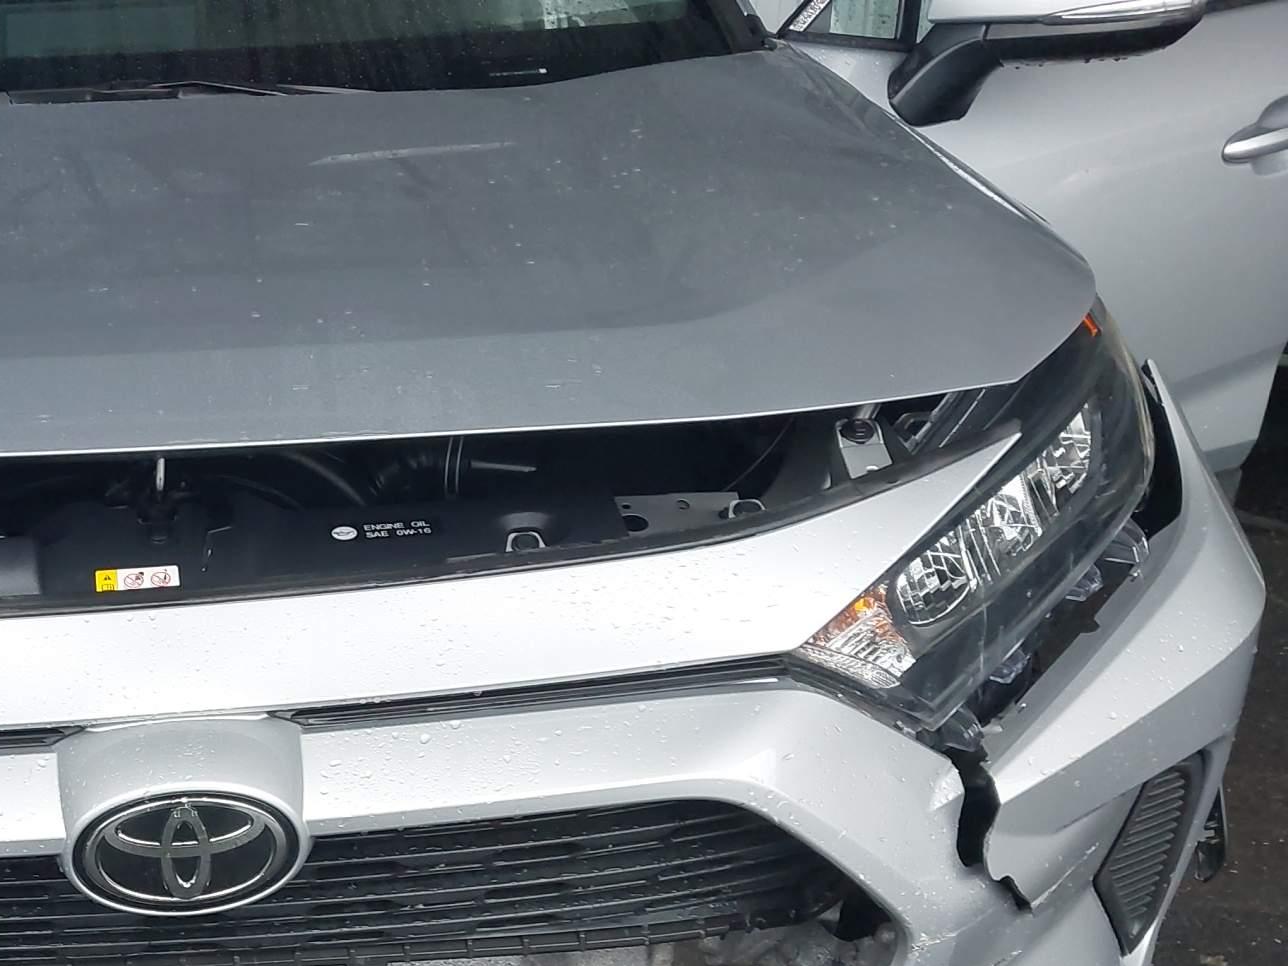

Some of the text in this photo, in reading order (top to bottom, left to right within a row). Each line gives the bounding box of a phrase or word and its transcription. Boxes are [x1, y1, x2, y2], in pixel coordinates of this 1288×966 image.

[363, 523, 405, 531] ENGINE
[366, 528, 432, 539] SAE 0W-16
